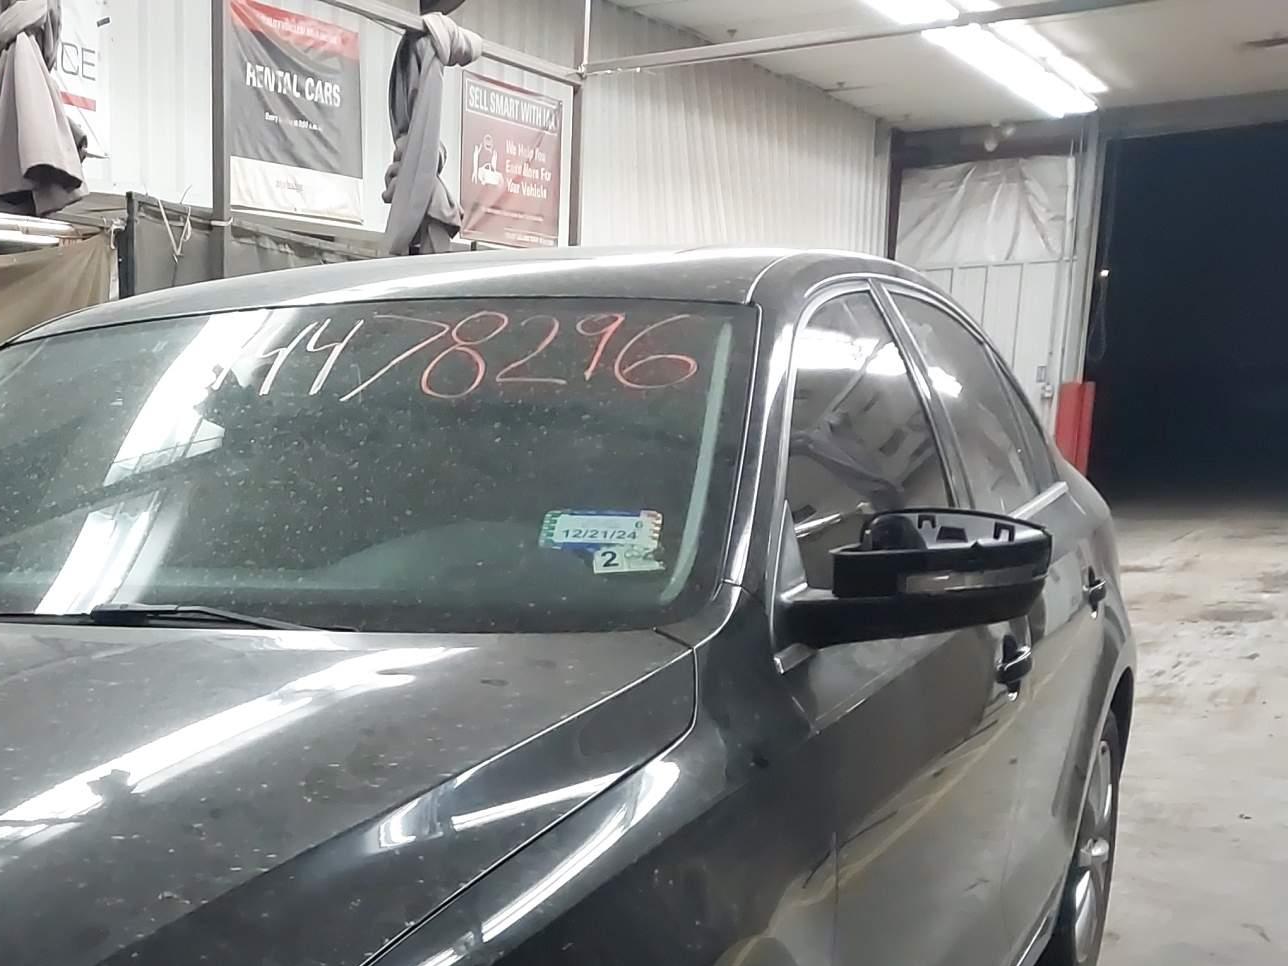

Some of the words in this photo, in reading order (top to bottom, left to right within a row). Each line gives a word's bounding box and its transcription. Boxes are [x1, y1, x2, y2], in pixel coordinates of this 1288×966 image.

[246, 62, 300, 98] RENTAL
[304, 77, 341, 108] CARS
[469, 85, 488, 112] SELL
[489, 92, 519, 120] SMART
[520, 101, 542, 128] WITH
[505, 139, 516, 156] We
[562, 528, 638, 540] 12/21/24
[600, 550, 620, 568] 2
